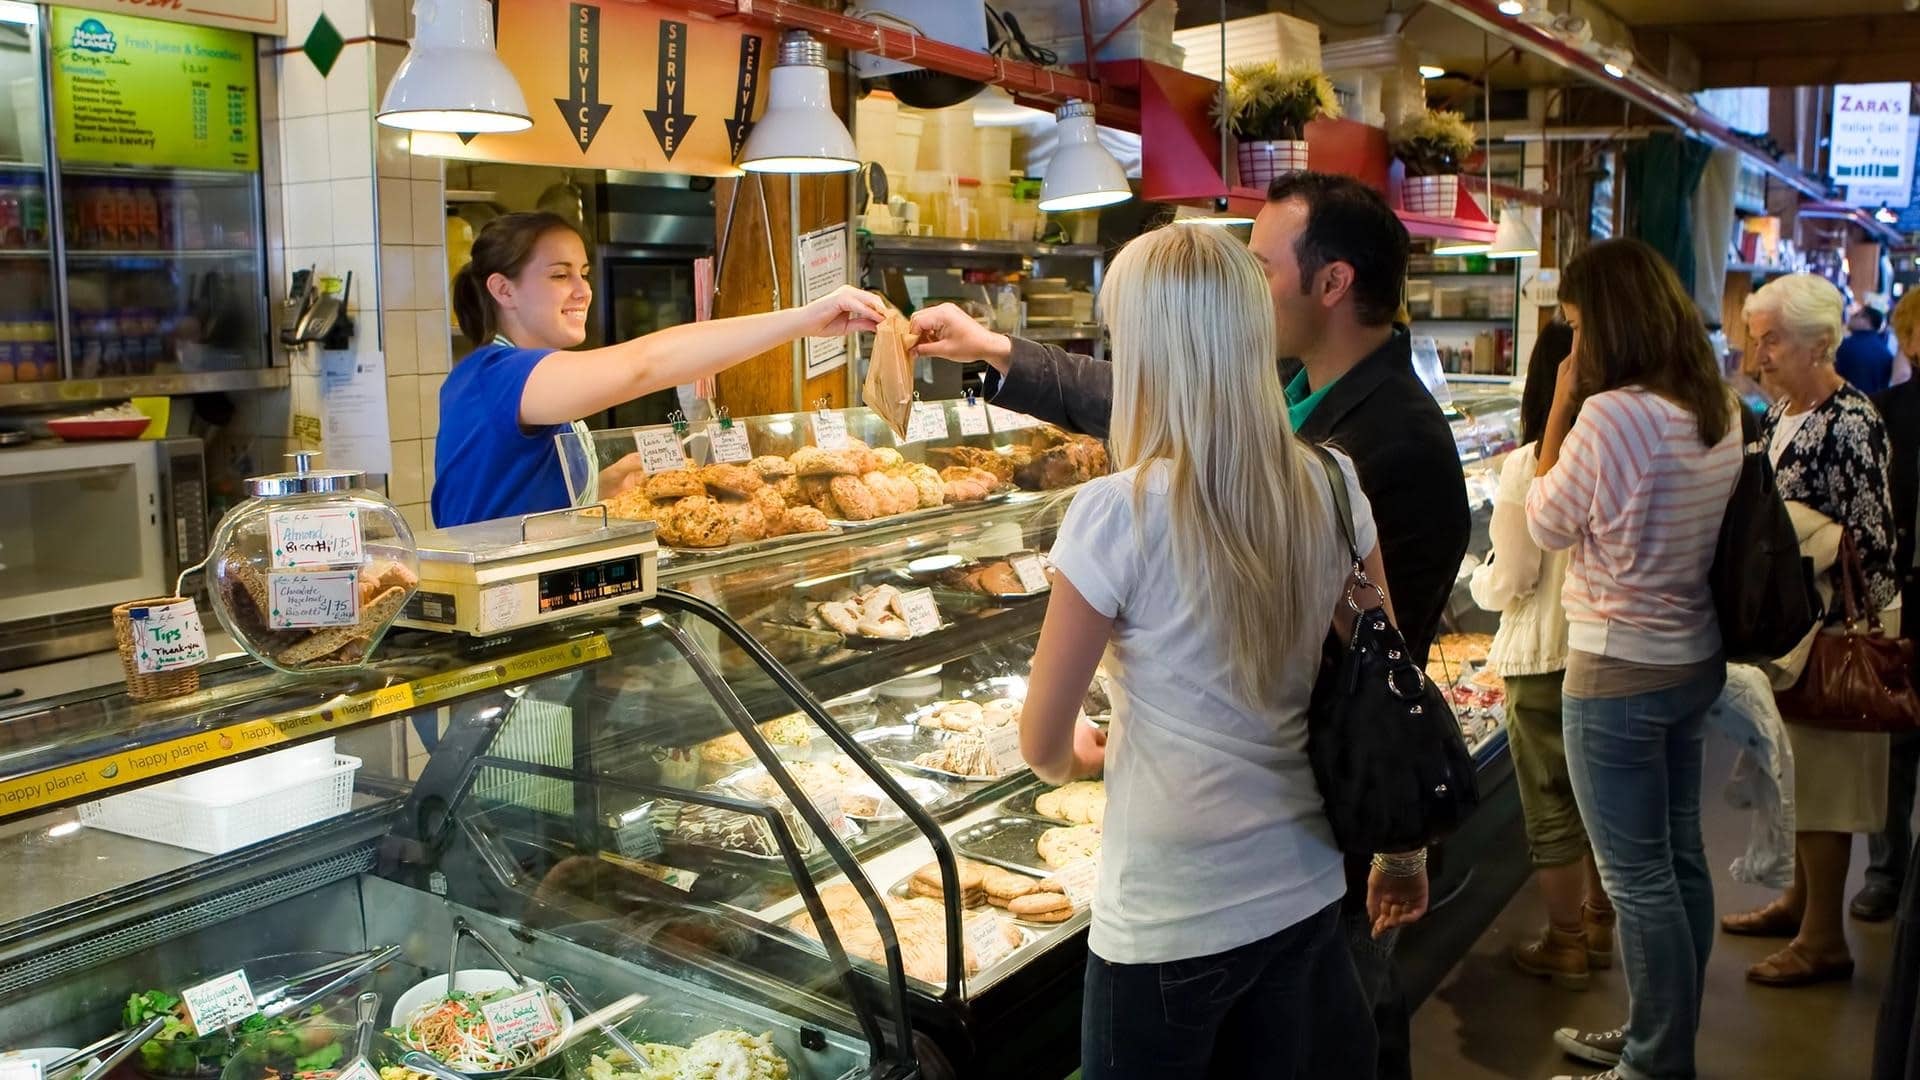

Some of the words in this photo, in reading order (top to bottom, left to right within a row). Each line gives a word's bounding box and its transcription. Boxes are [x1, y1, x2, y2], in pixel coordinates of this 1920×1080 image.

[73, 37, 115, 51] PLANET
[76, 29, 113, 42] HAPPY
[125, 35, 152, 49] Fresh
[578, 8, 589, 143] SERVICE
[665, 24, 677, 151] SERVICE
[734, 38, 754, 156] SERVICE
[1841, 95, 1901, 112] ZARA'S
[283, 522, 327, 541] Almond
[511, 659, 538, 672] happy
[540, 652, 565, 666] planet
[374, 690, 406, 709] planet
[241, 724, 276, 742] happy
[278, 715, 313, 734] planet
[128, 752, 168, 770] happy
[171, 739, 210, 760] planet
[45, 771, 89, 793] planet
